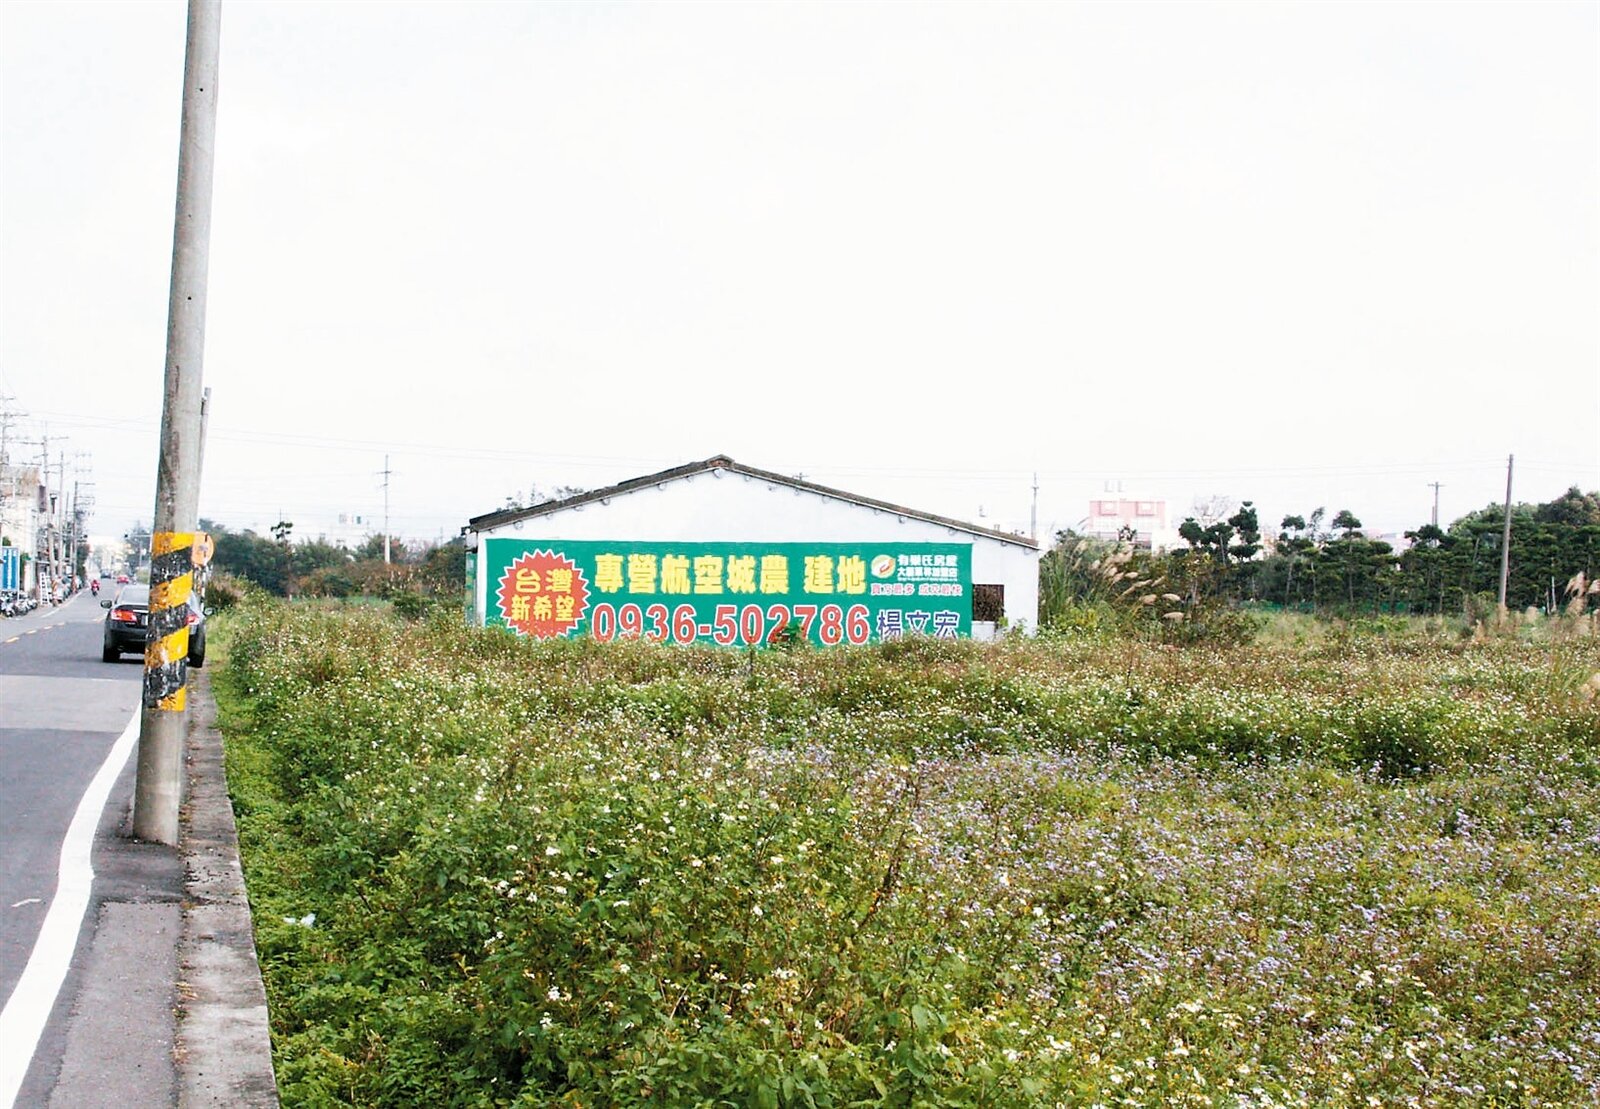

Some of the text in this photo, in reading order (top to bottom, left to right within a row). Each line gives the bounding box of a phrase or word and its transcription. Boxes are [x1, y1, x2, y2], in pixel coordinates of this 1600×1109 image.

[515, 567, 574, 594] 台灣
[594, 553, 867, 594] 專營航空城農 建地
[511, 595, 576, 622] 新希望
[592, 603, 960, 645] 0936-502786 楊文宏
